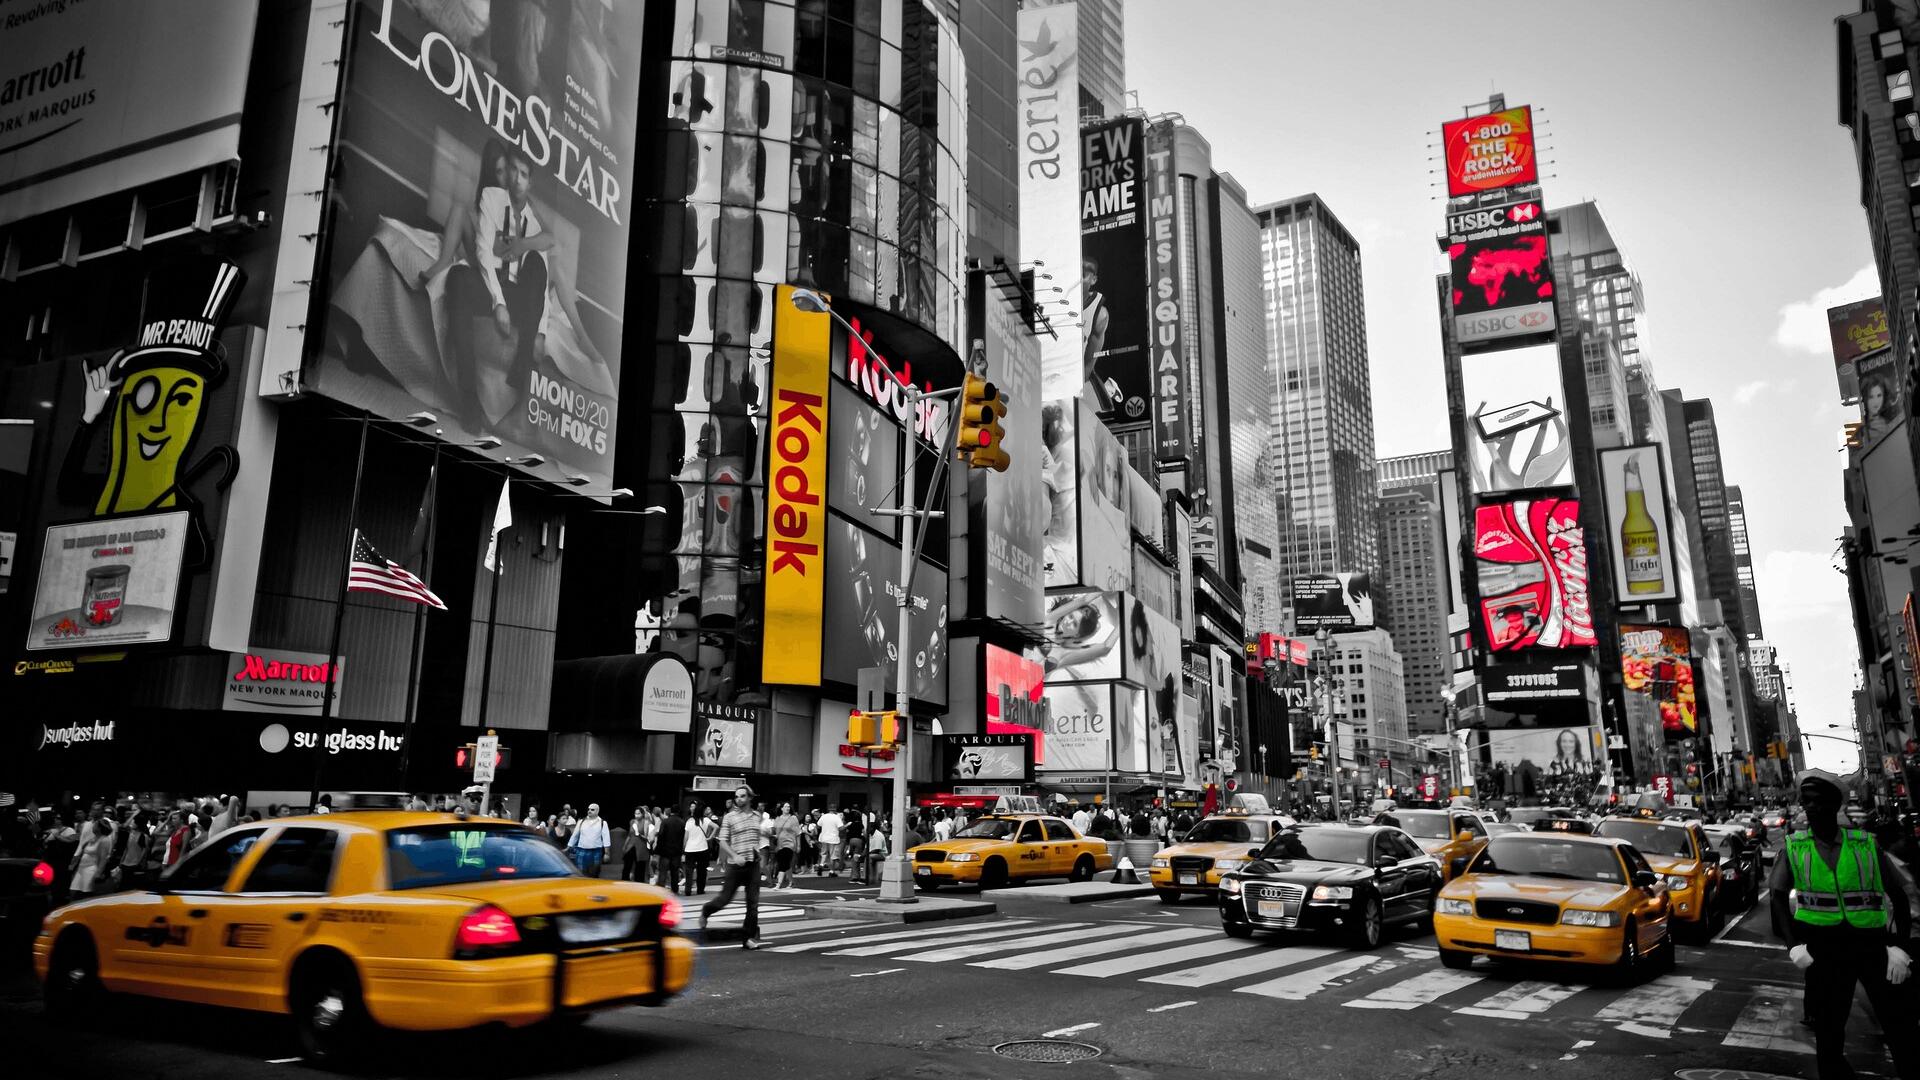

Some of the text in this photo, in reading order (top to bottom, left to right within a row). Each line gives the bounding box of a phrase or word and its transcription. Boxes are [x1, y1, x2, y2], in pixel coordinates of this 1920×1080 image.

[28, 89, 97, 124] MARQUIS
[564, 91, 580, 113] Two
[1025, 64, 1060, 180] aerie
[1462, 122, 1512, 143] 1-800
[1470, 140, 1506, 157] THE
[1464, 152, 1516, 175] ROCK
[1449, 209, 1505, 234] HSBC
[1146, 150, 1180, 423] TIMES SQUARE
[140, 319, 215, 350] MR. PEANUT
[1463, 315, 1516, 336] HSBC
[530, 369, 609, 430] MON 9/20
[560, 412, 594, 450] FOX
[594, 430, 607, 455] 5
[1162, 439, 1180, 448] NYC
[773, 388, 822, 577] Kodak
[235, 655, 338, 684] Marriott
[229, 684, 338, 700] NEW YORK MARQUS
[650, 687, 686, 700] Marriott
[1000, 683, 1031, 725] Bank
[697, 702, 756, 720] MARQUIS
[46, 720, 116, 749] sunglass hut
[377, 730, 405, 751] hu
[949, 735, 1027, 744] MARQUIS
